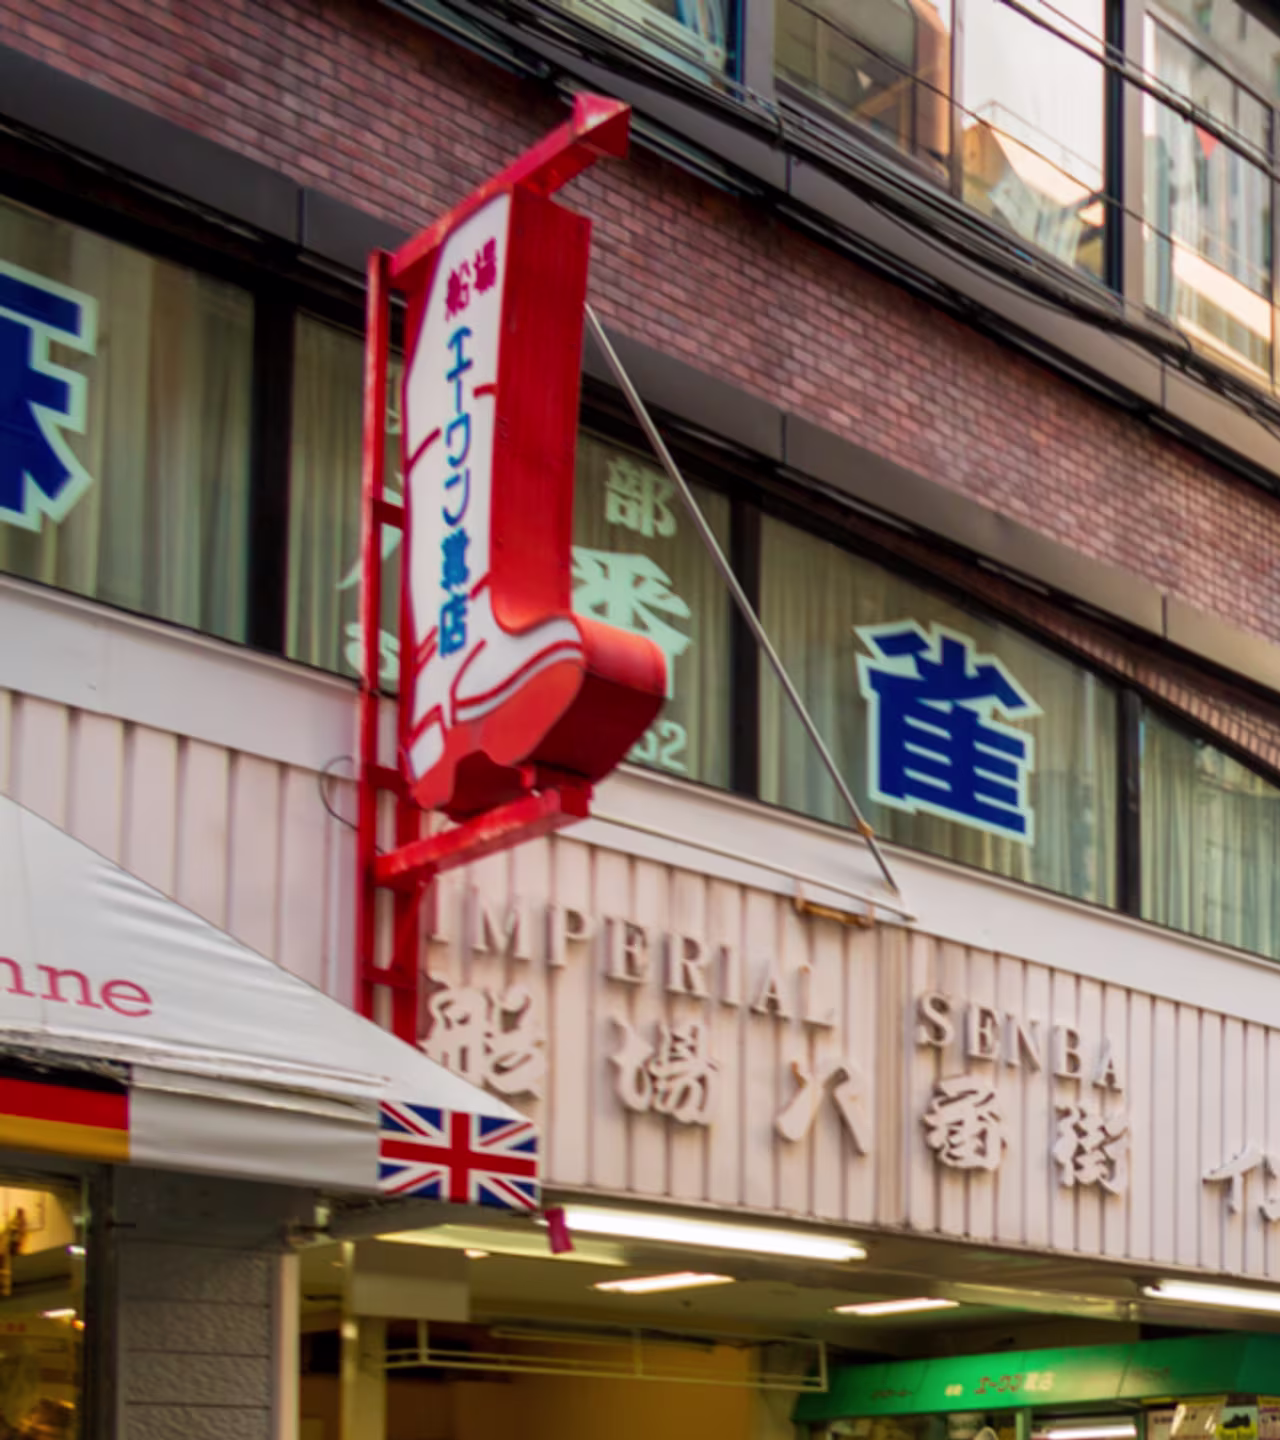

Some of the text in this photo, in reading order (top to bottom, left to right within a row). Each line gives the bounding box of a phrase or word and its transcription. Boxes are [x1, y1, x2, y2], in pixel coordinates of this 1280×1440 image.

[853, 618, 1046, 848] 雀
[428, 876, 836, 1030] IMPERIAL
[916, 991, 1125, 1094] SENBA
